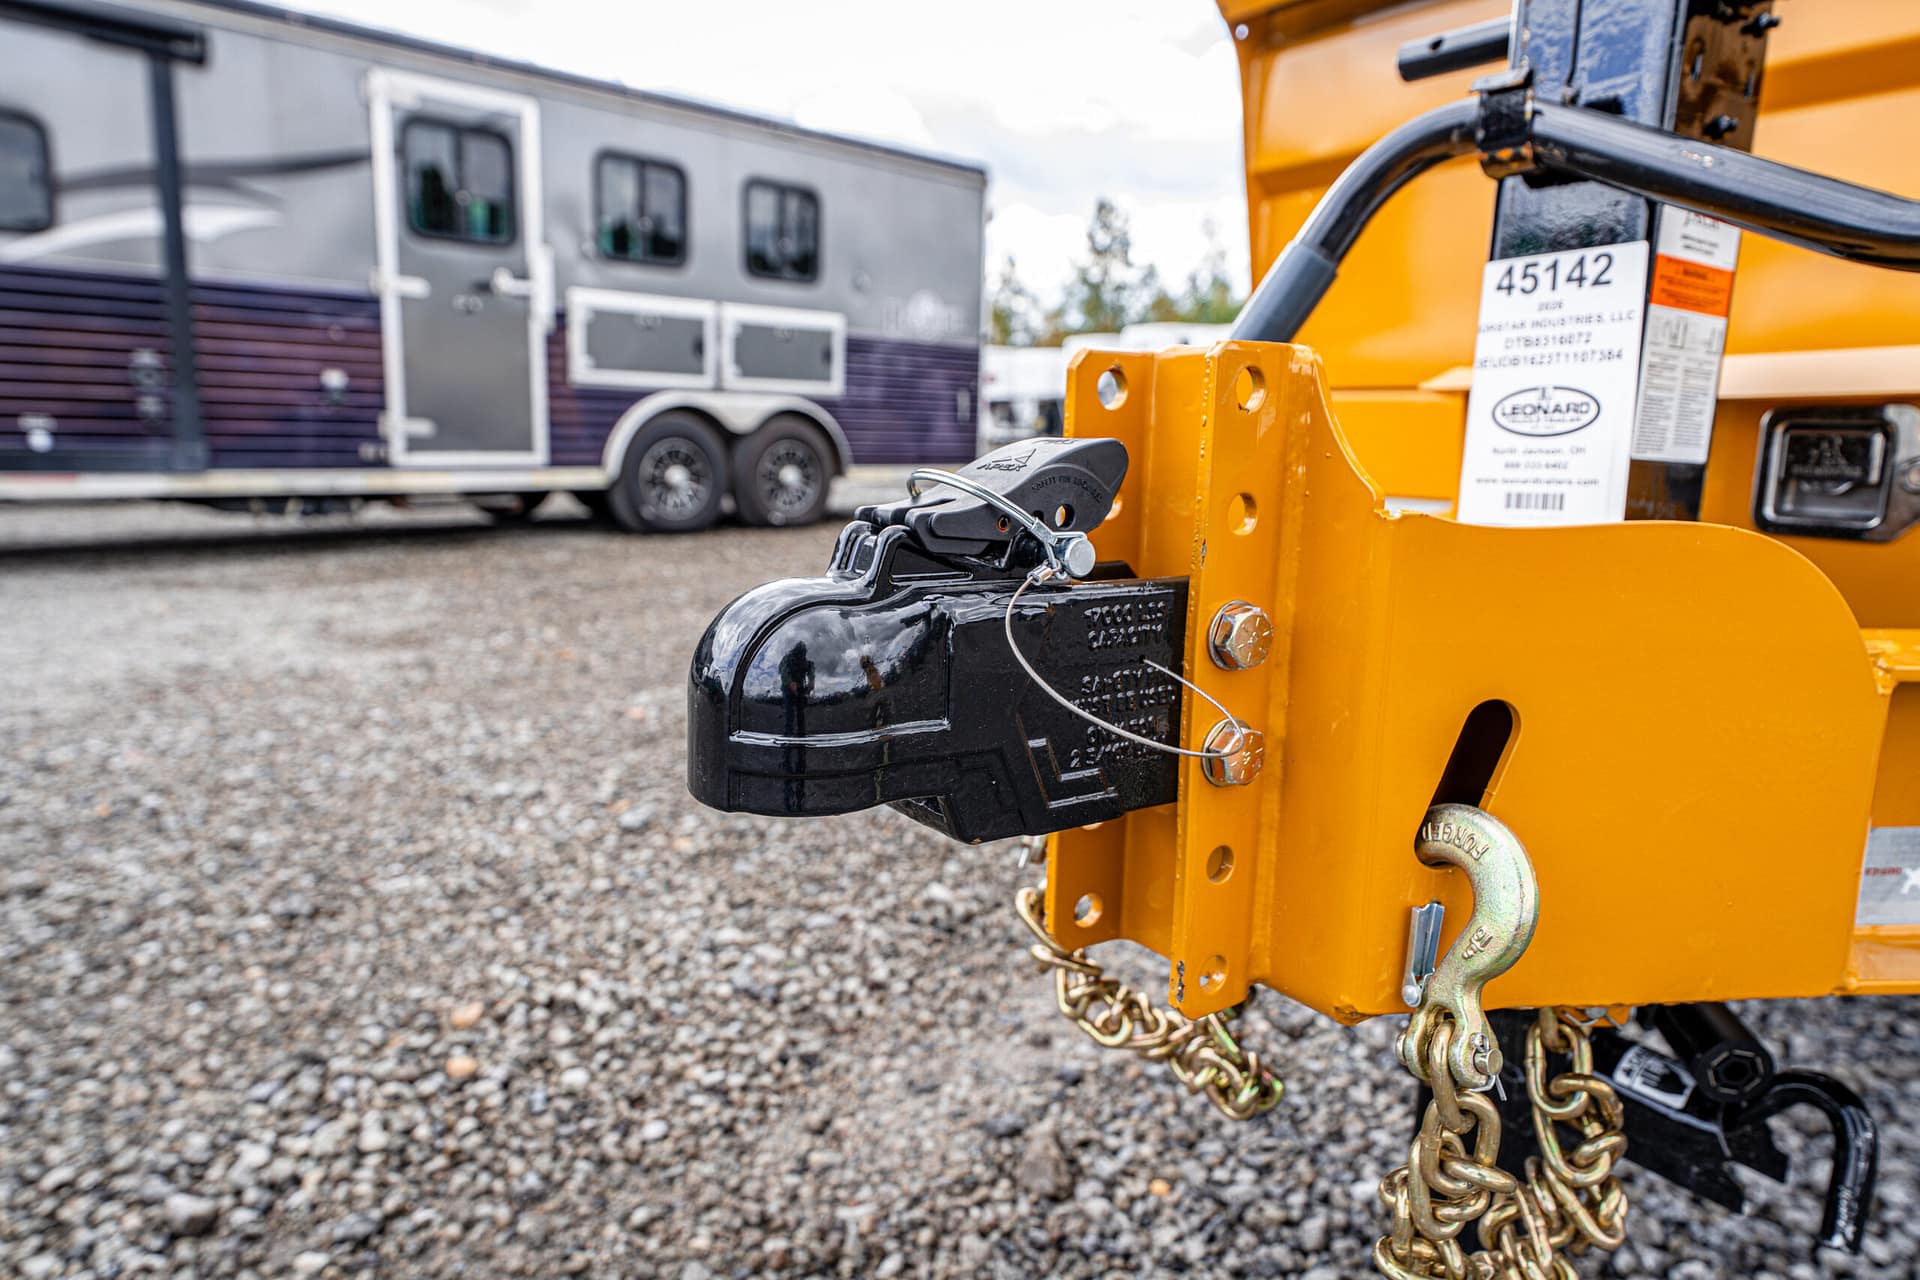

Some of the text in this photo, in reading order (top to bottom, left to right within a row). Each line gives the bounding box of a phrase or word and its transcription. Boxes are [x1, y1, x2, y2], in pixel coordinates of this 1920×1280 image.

[1496, 253, 1614, 296] 45142
[1501, 401, 1591, 417] LEONARD
[976, 460, 1029, 473] APEX
[1422, 822, 1490, 861] FORGED
